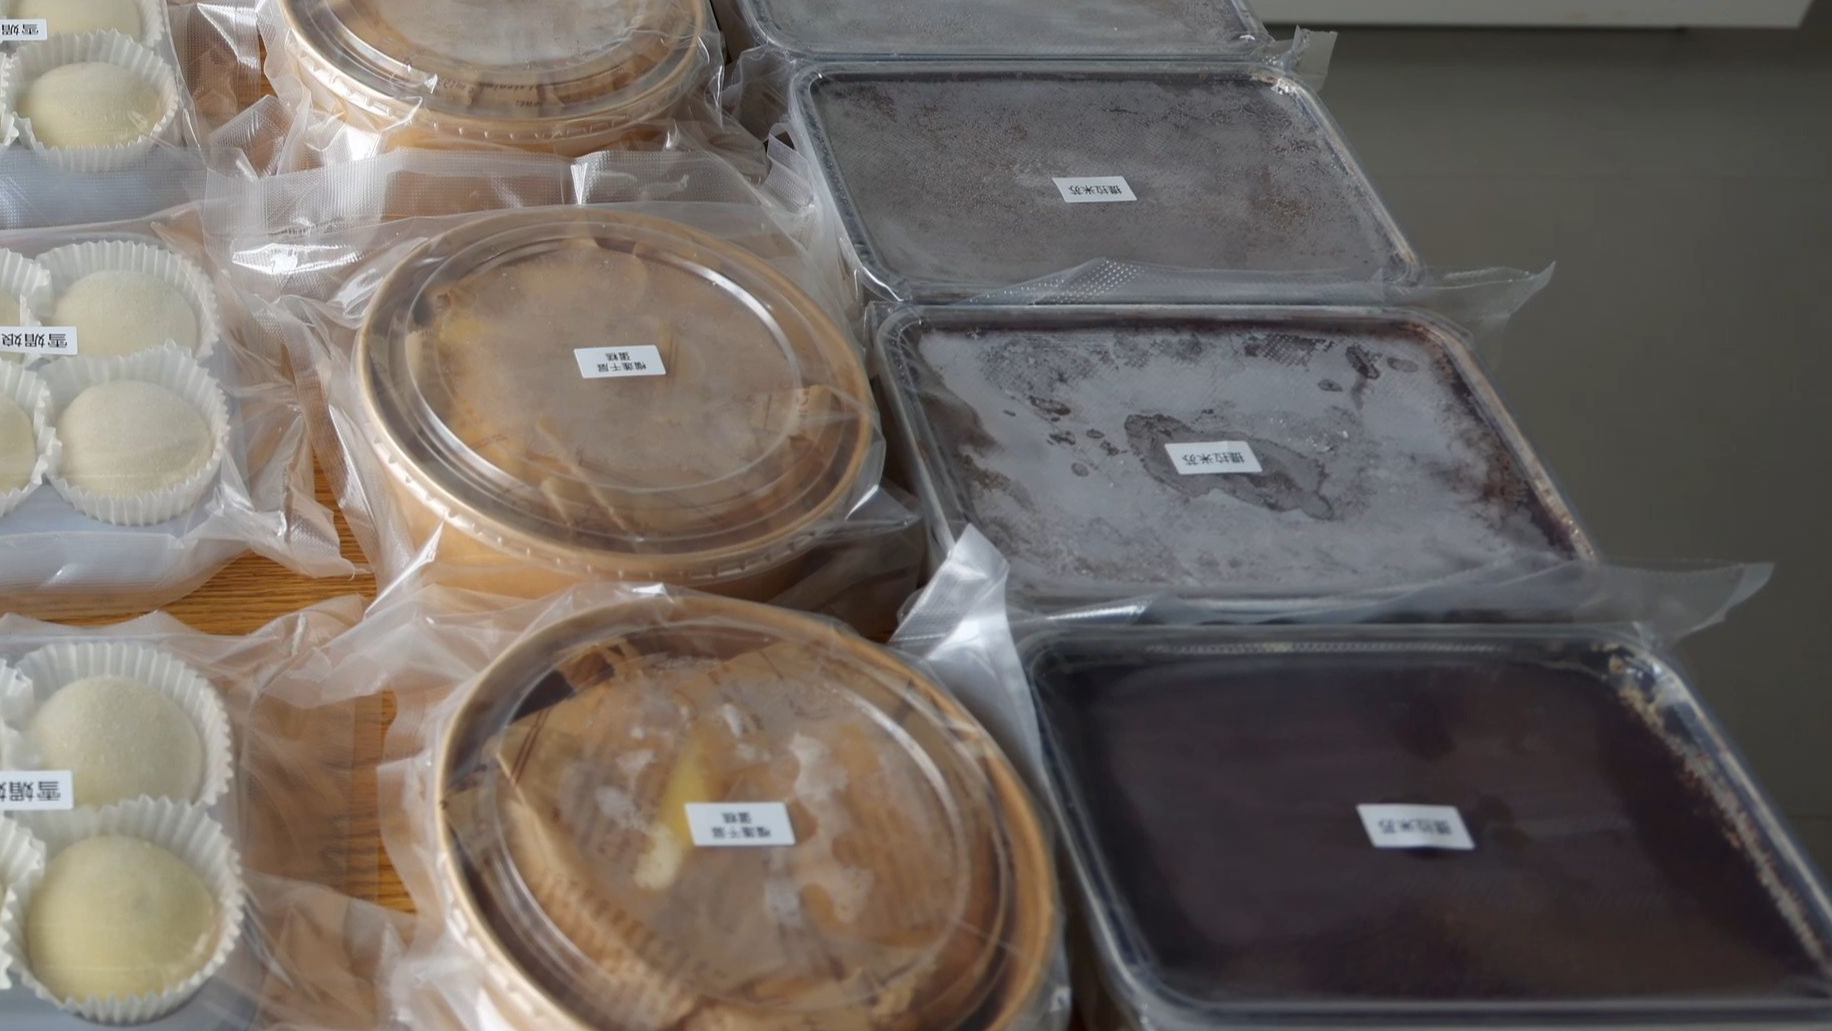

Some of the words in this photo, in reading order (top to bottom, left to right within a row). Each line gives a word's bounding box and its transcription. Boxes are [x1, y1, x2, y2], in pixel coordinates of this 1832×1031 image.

[1067, 184, 1122, 195] 提拉米苏
[0, 332, 67, 348] 雪媚娘
[605, 352, 631, 361] 蛋糕
[597, 363, 646, 373] 榴莲千层
[1182, 450, 1245, 465] 提拉米苏
